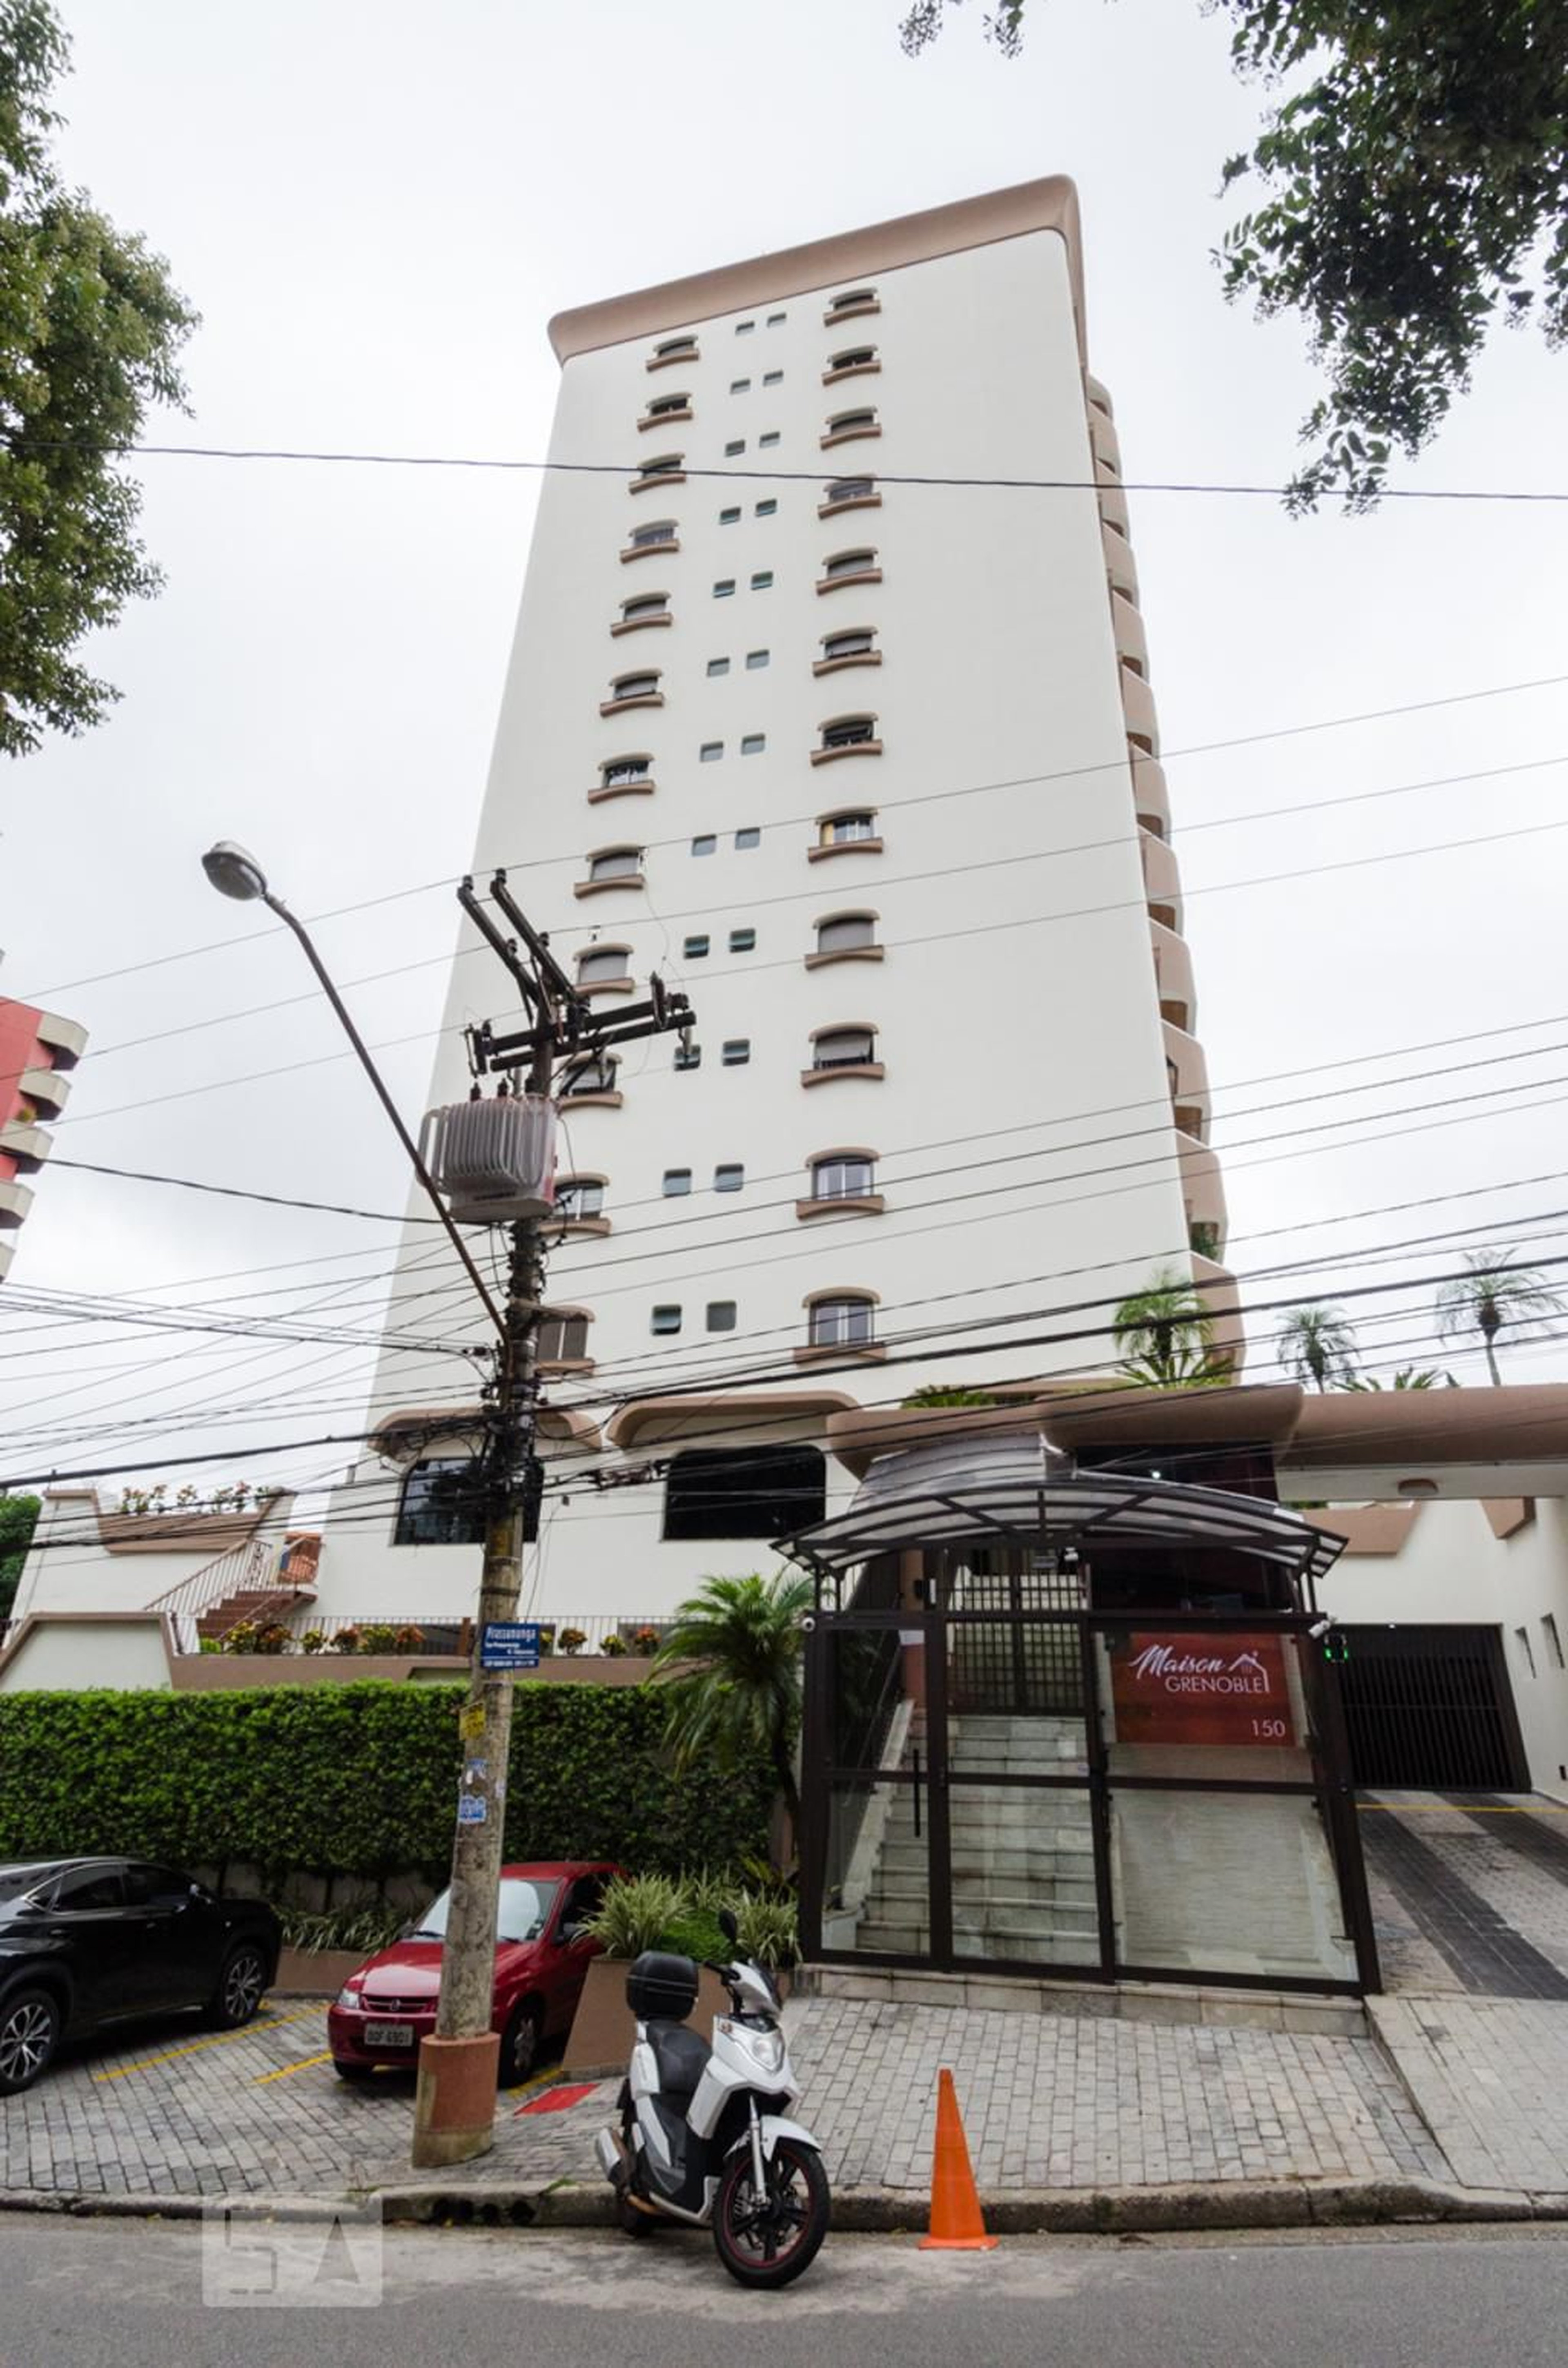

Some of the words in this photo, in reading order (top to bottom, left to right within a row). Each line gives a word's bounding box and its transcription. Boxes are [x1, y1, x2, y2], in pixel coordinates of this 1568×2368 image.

[1128, 1644, 1226, 1679] Maison
[1165, 1676, 1263, 1693] GRENOBLE
[1252, 1720, 1285, 1737] 150
